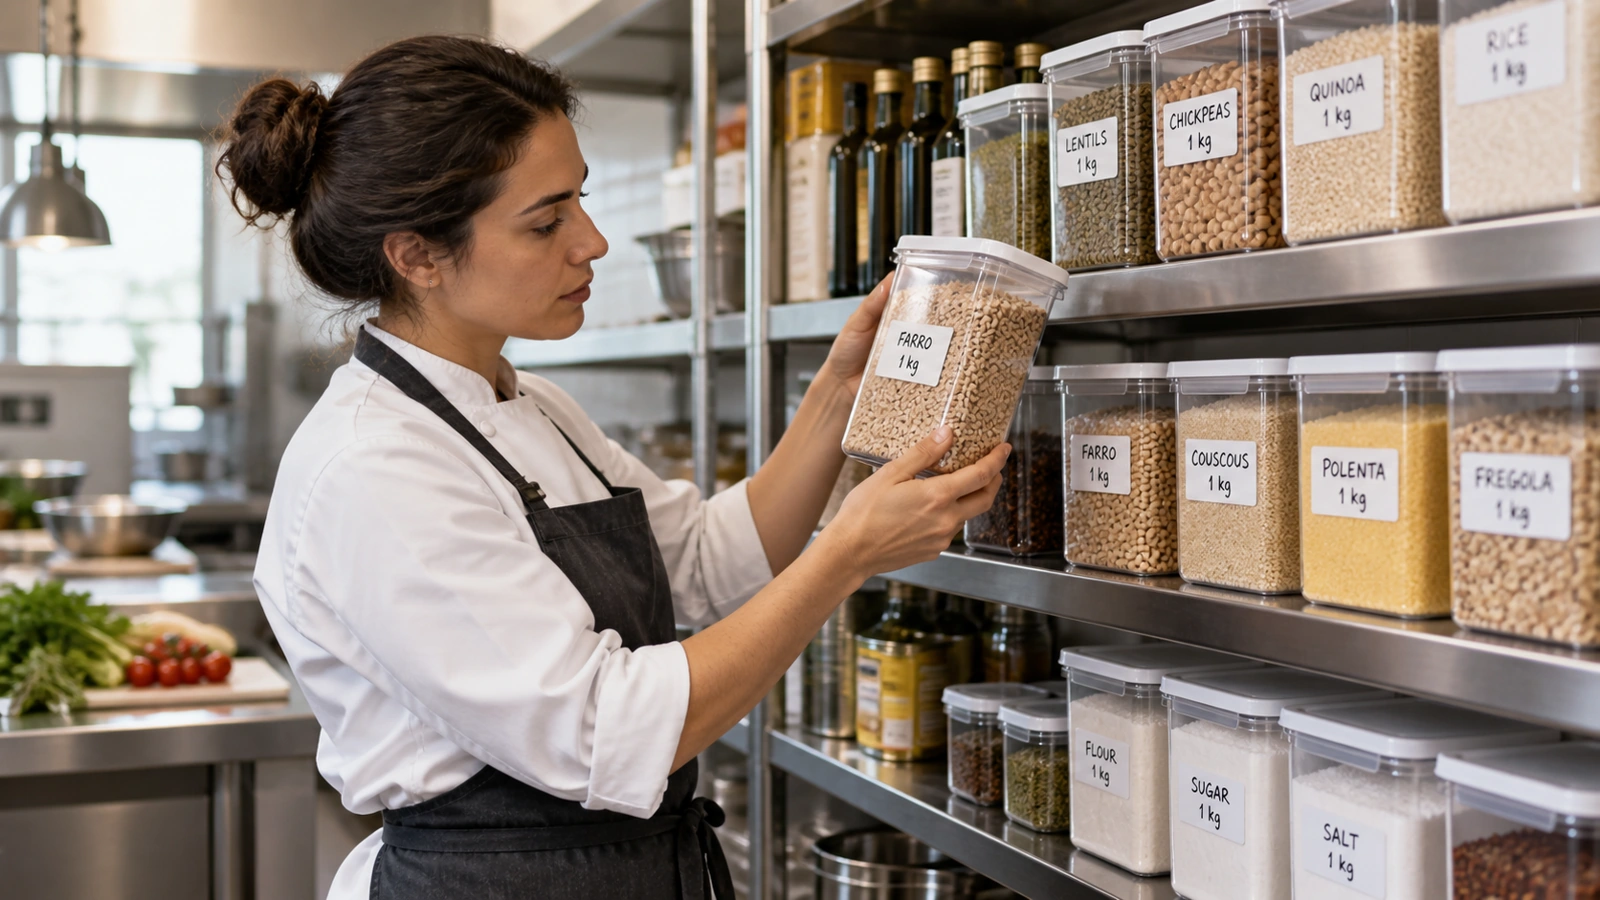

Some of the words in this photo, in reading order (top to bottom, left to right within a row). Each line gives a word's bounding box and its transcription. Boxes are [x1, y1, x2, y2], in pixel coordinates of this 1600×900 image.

[1487, 22, 1529, 52] RICE
[1492, 64, 1498, 82] 1
[1506, 62, 1526, 86] kg
[1310, 73, 1365, 102] QUINOA
[1169, 101, 1231, 131] CHICKPEAS
[1324, 108, 1328, 128] 1
[1336, 106, 1352, 130] kg
[1065, 129, 1107, 153] LENTILS
[1188, 134, 1192, 150] 1
[1198, 132, 1212, 154] kg
[1076, 158, 1082, 174] 1
[1086, 156, 1096, 176] kg
[897, 331, 933, 350] FARRO
[898, 354, 906, 368] 1
[906, 354, 920, 376] kg
[1081, 443, 1117, 460] FARRO
[1191, 450, 1250, 470] COUSCOUS
[1090, 466, 1094, 482] 1
[1098, 466, 1110, 488] kg
[1322, 457, 1386, 480] POLENTA
[1475, 466, 1553, 493] FREGOLA
[1208, 474, 1214, 492] 1
[1218, 476, 1232, 498] kg
[1338, 488, 1344, 504] 1
[1350, 488, 1366, 514] kg
[1496, 500, 1502, 518] 1
[1509, 502, 1530, 529] kg
[1085, 740, 1118, 765] FLOUR
[1092, 764, 1096, 778] 1
[1100, 766, 1110, 788] kg
[1191, 776, 1230, 805] SUGAR
[1198, 802, 1204, 820] 1
[1208, 806, 1220, 830] kg
[1323, 823, 1359, 851] SALT
[1328, 852, 1332, 868] 1
[1338, 854, 1354, 882] kg
